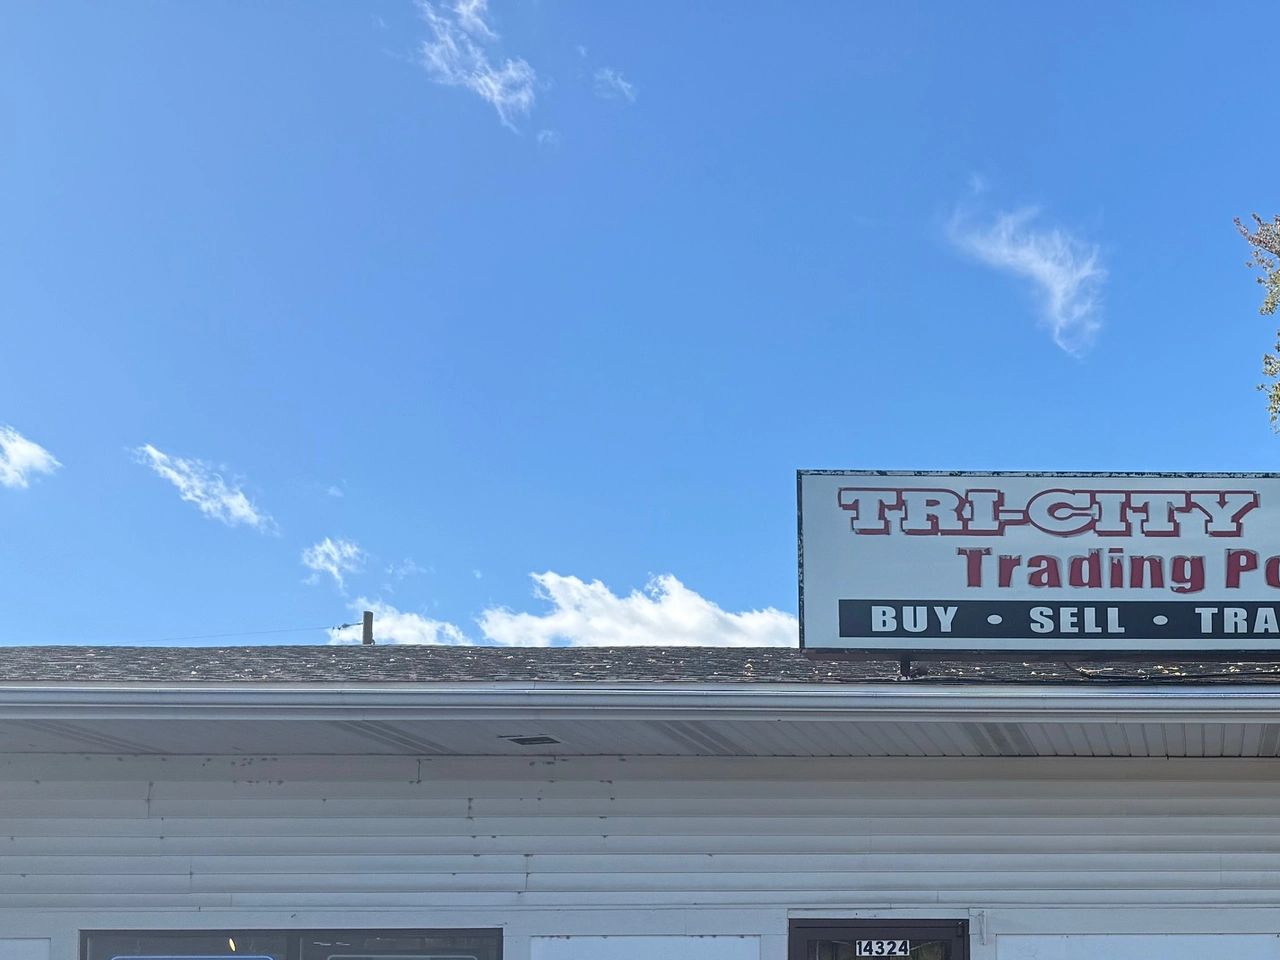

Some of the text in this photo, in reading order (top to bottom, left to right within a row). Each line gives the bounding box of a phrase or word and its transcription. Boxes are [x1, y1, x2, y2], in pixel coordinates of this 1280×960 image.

[838, 488, 1260, 537] TRI-CITY
[957, 547, 1205, 593] Trading
[871, 606, 958, 632] BUY
[1030, 607, 1126, 633] SELL
[857, 940, 908, 955] 14324
